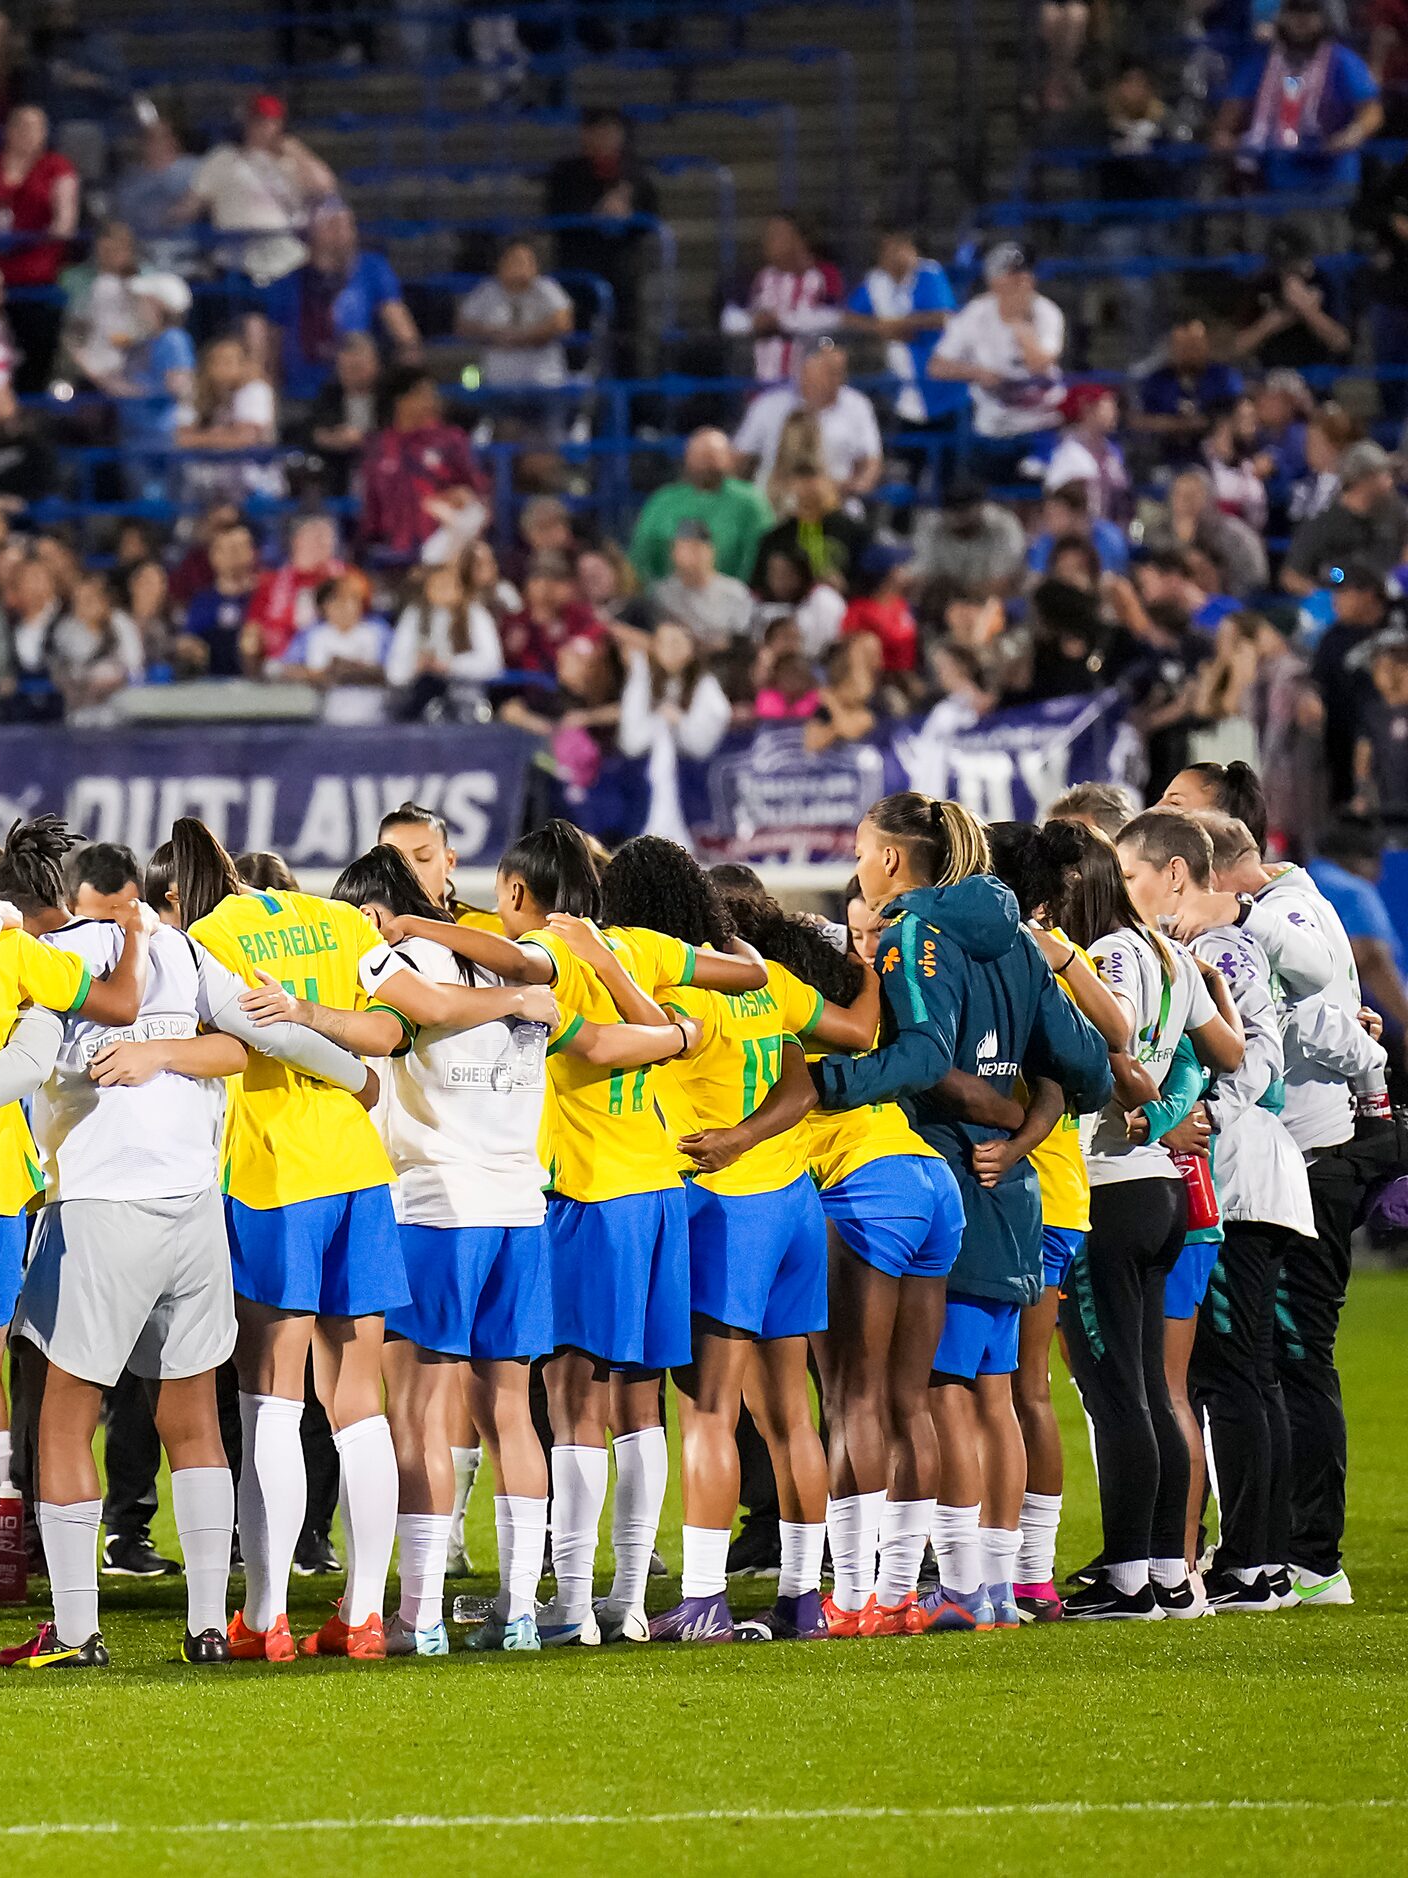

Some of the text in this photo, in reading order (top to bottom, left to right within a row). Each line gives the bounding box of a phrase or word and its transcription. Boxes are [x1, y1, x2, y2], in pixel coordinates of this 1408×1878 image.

[237, 921, 338, 965] RAFAELLE
[918, 939, 937, 978] vivo
[1107, 952, 1124, 983] vivo
